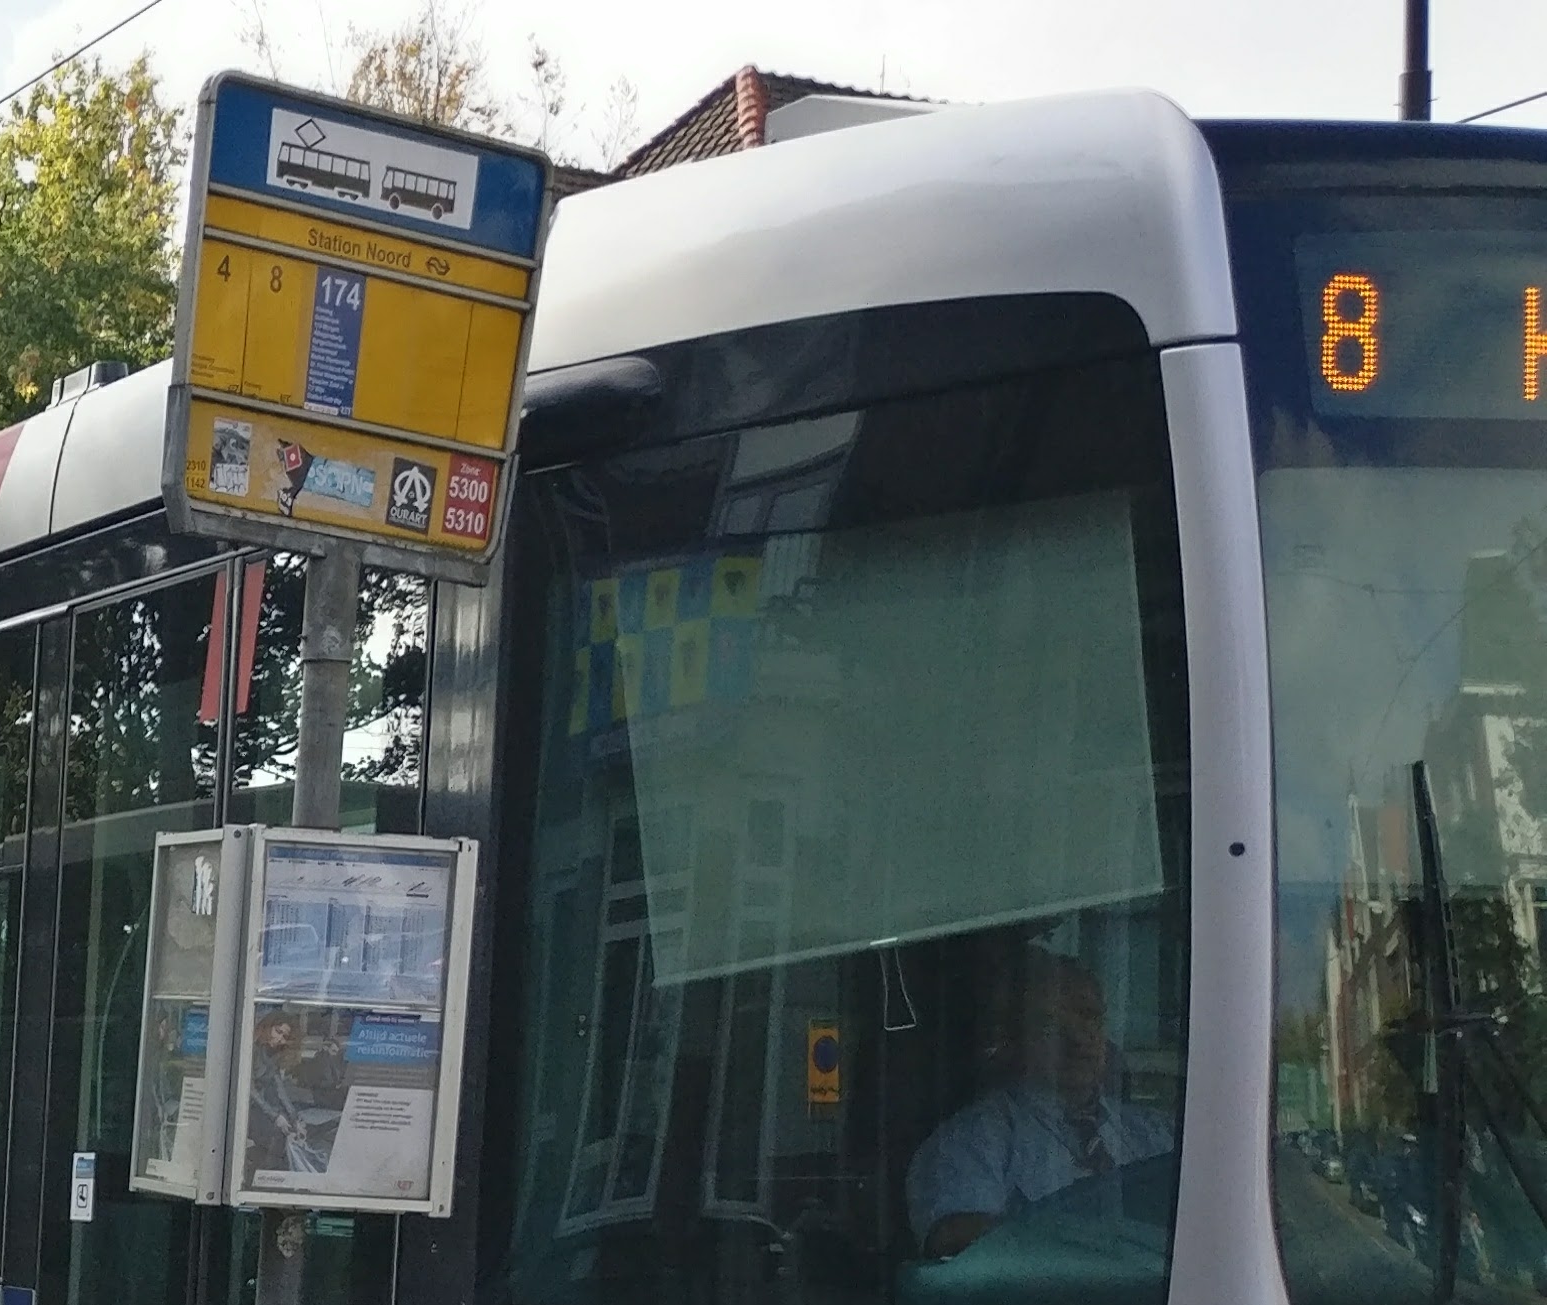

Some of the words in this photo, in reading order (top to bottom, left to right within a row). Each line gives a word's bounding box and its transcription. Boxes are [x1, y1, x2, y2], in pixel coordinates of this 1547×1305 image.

[308, 228, 361, 257] Station
[366, 240, 412, 269] Noord
[218, 254, 232, 282] 4
[270, 265, 284, 294] 8
[321, 275, 361, 311] 174
[1320, 273, 1380, 392] 8
[448, 475, 489, 504] 5300
[443, 506, 485, 535] 5310
[358, 1028, 386, 1042] Altijd
[388, 1031, 427, 1043] actuele
